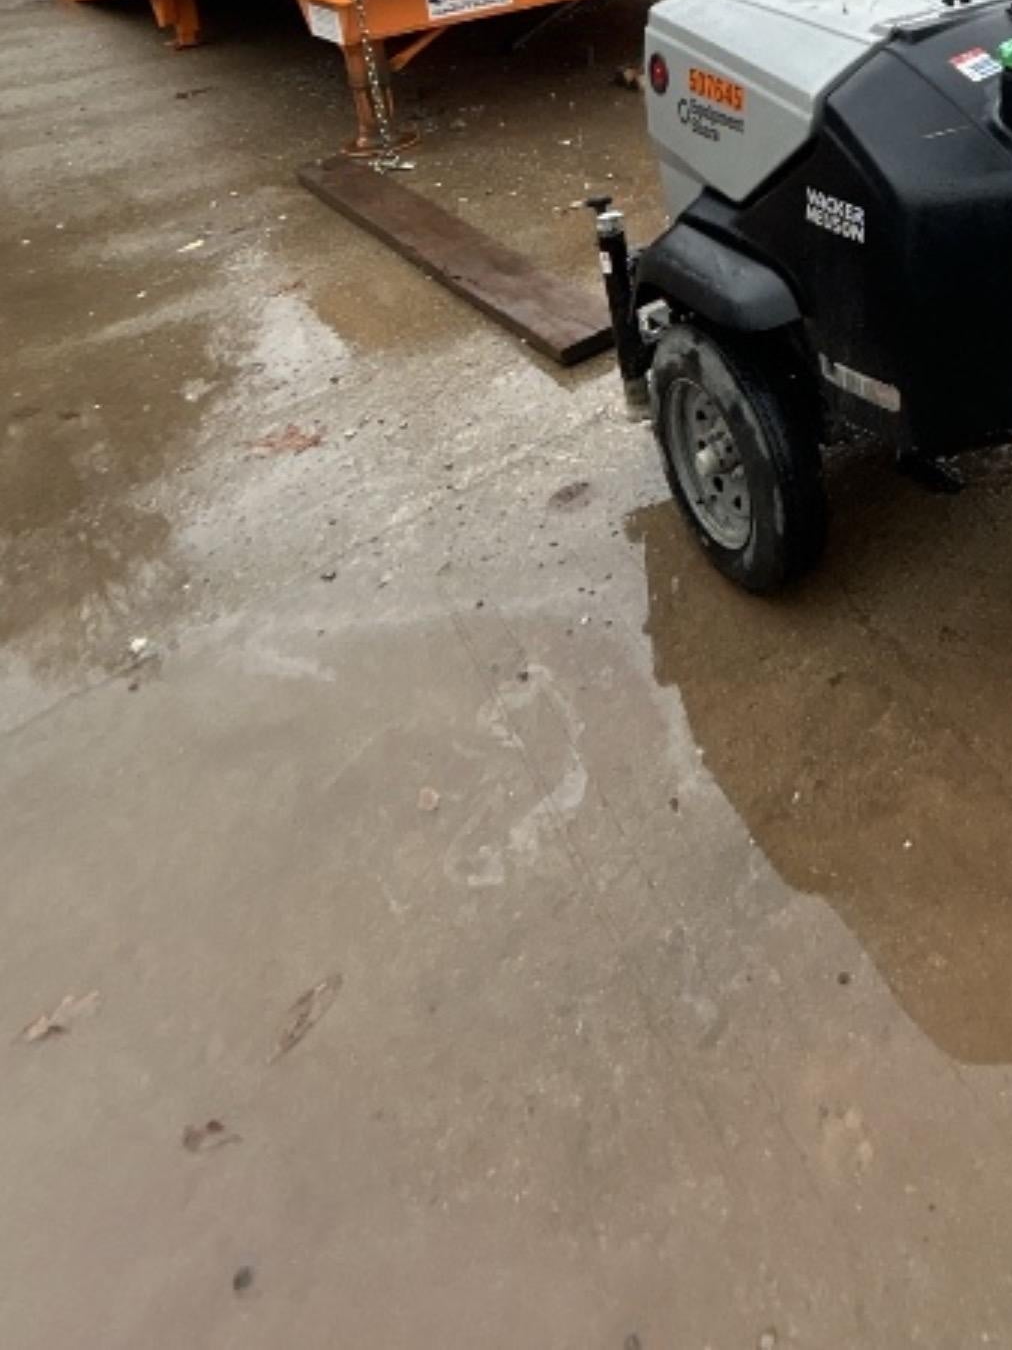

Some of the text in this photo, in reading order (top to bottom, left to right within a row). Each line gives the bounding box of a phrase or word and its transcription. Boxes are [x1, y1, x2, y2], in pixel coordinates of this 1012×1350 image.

[688, 68, 745, 112] 507645
[806, 185, 865, 227] WACKER
[806, 203, 865, 244] NEUSON
